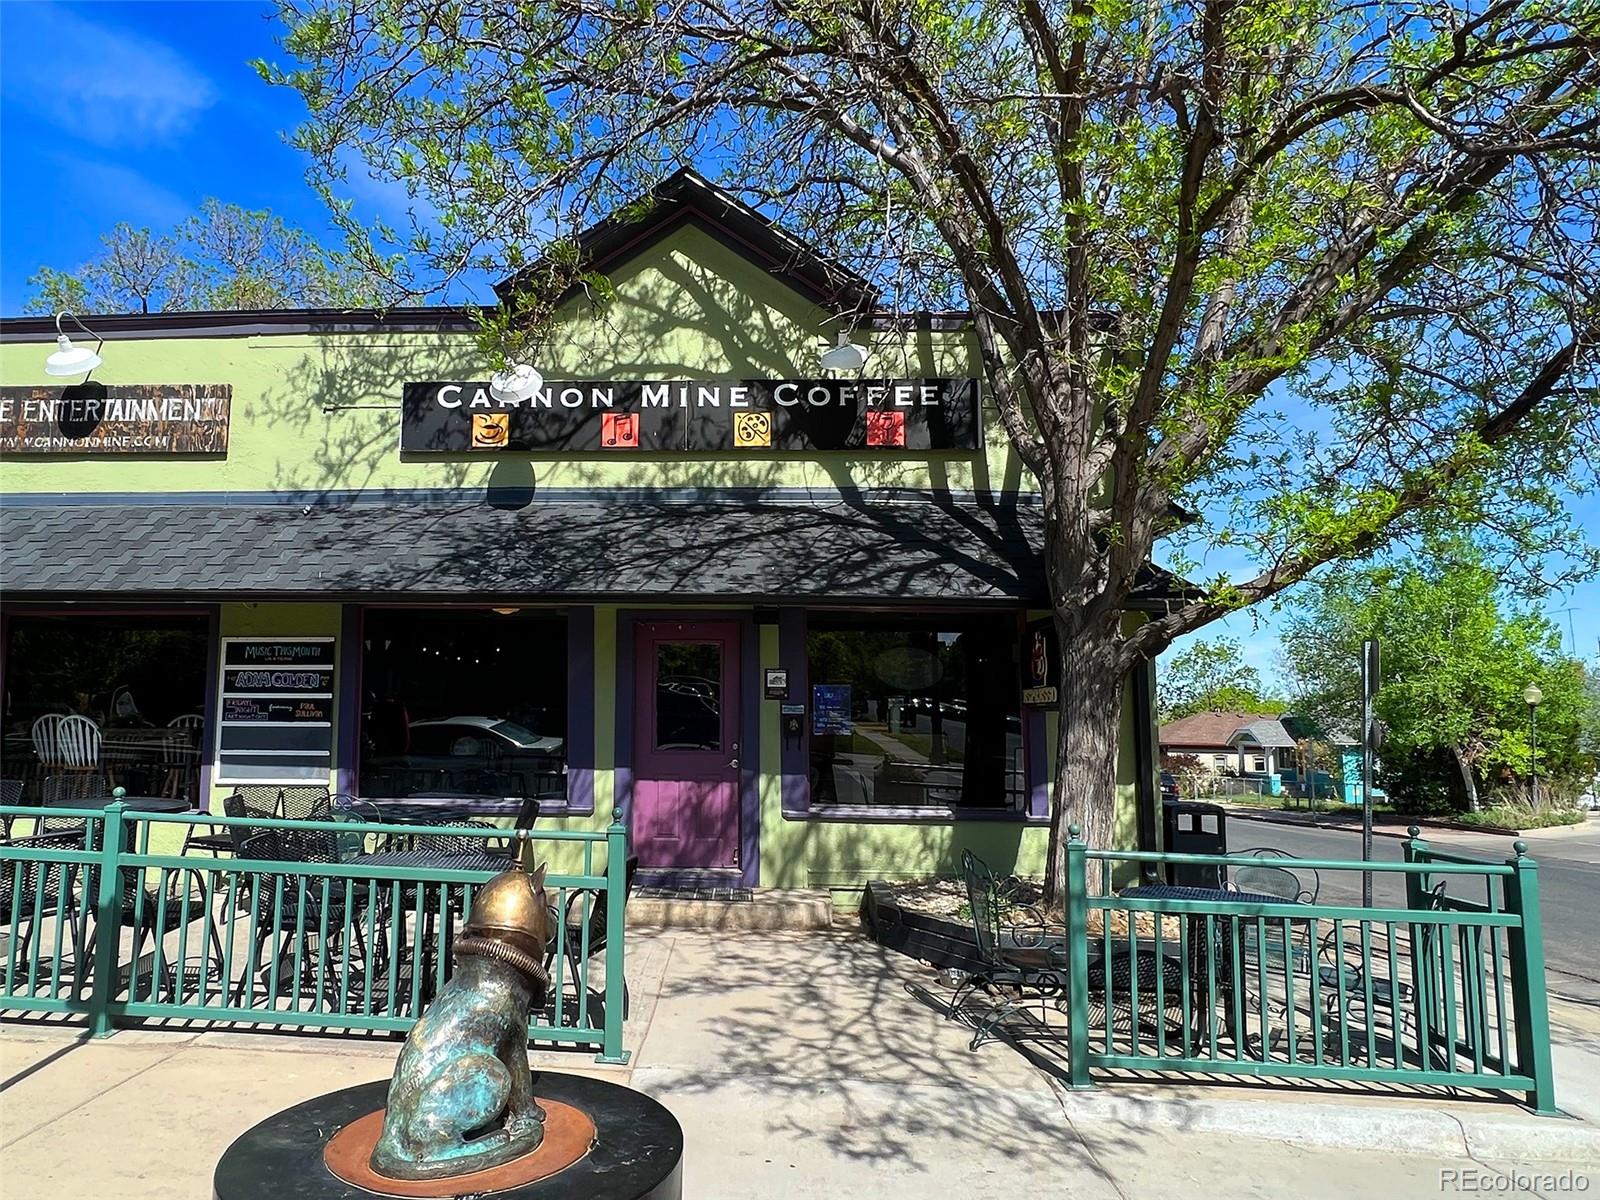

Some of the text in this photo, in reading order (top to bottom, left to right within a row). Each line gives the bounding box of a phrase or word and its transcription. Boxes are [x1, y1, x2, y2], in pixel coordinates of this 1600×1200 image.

[436, 383, 939, 409] CANON MINE COFFEE
